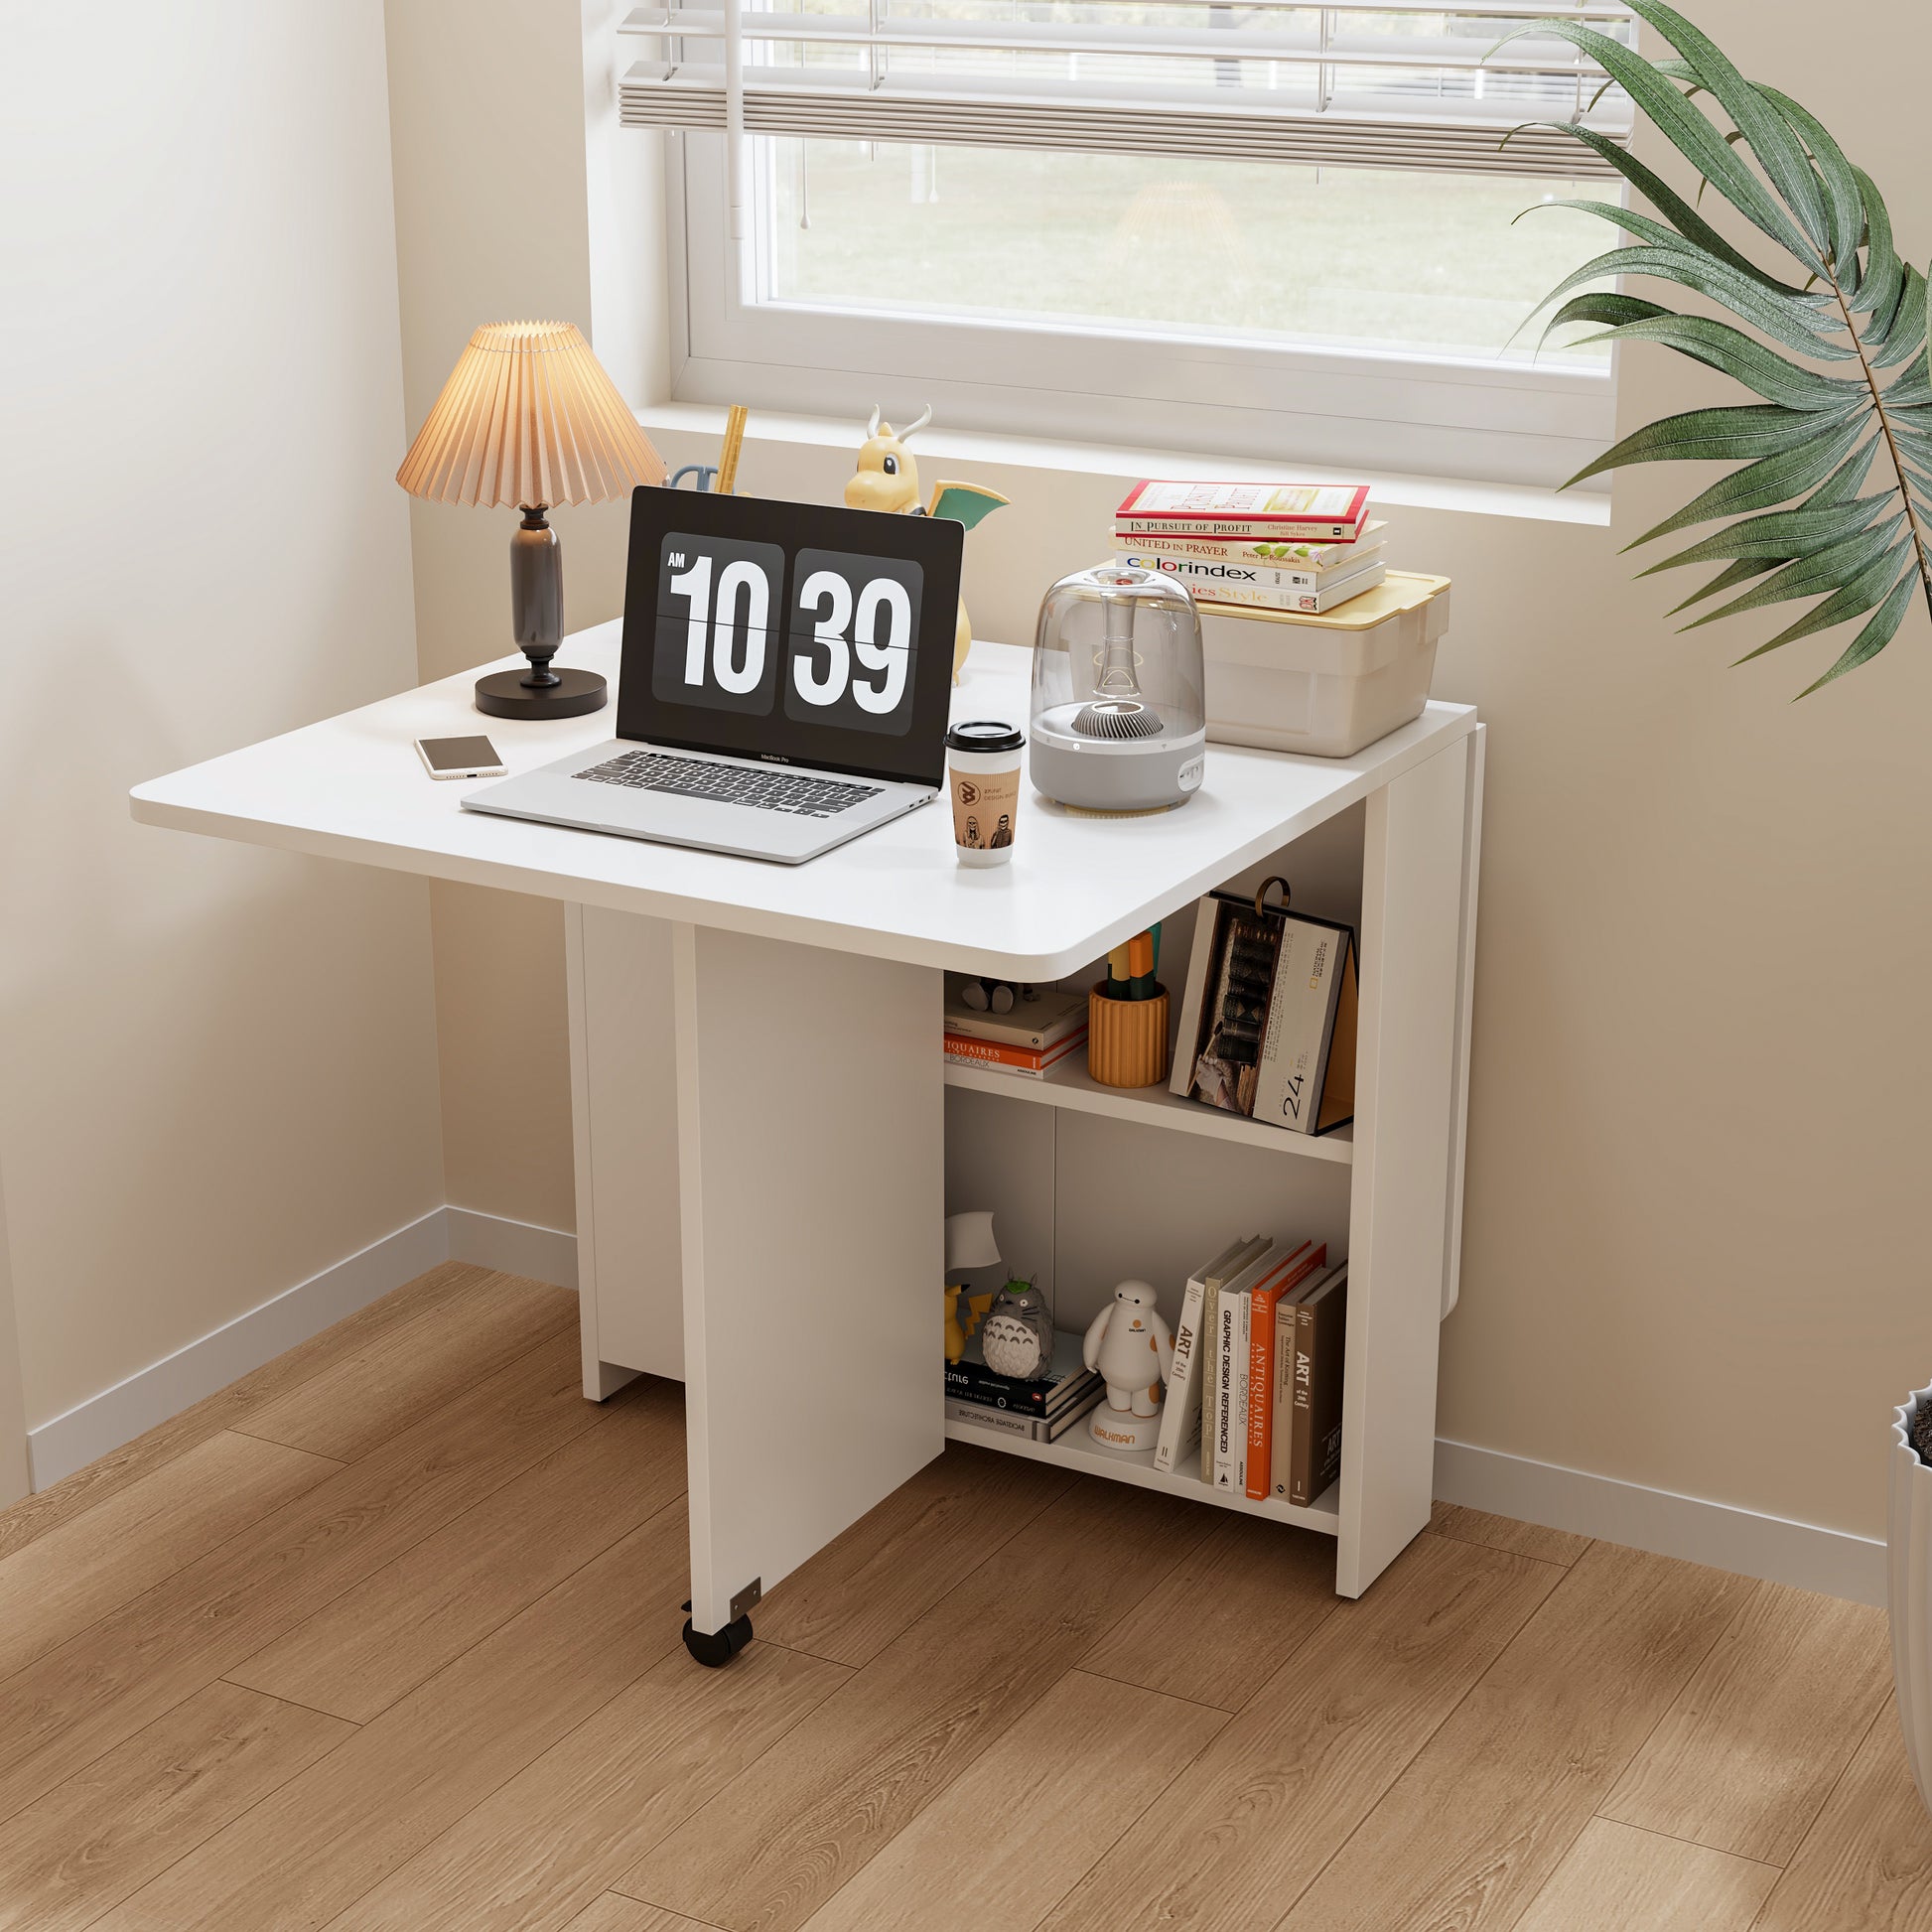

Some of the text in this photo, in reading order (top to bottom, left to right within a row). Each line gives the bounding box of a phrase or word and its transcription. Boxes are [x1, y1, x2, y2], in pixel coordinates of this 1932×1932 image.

[1131, 521, 1253, 534] IN PURSUIT OF PROFIT
[667, 552, 685, 569] AM
[1124, 537, 1171, 550] UNITED
[1185, 543, 1229, 557] PRAYER
[1127, 558, 1256, 581] colorindex
[1218, 587, 1269, 603] Style
[670, 556, 911, 715] 10 39
[944, 1040, 1000, 1058] IQUAIRES
[1283, 1073, 1305, 1120] 24
[1176, 1325, 1193, 1359] ART
[1222, 1310, 1232, 1352] GRAPHIC
[1221, 1354, 1230, 1390] DESIGN
[1296, 1351, 1311, 1386] ART
[1238, 1373, 1249, 1426] BORDEAUX
[1253, 1343, 1266, 1448] ANTIQUAIRES
[1093, 1424, 1136, 1445] WALKMAN
[1220, 1392, 1229, 1453] REFERENCED
